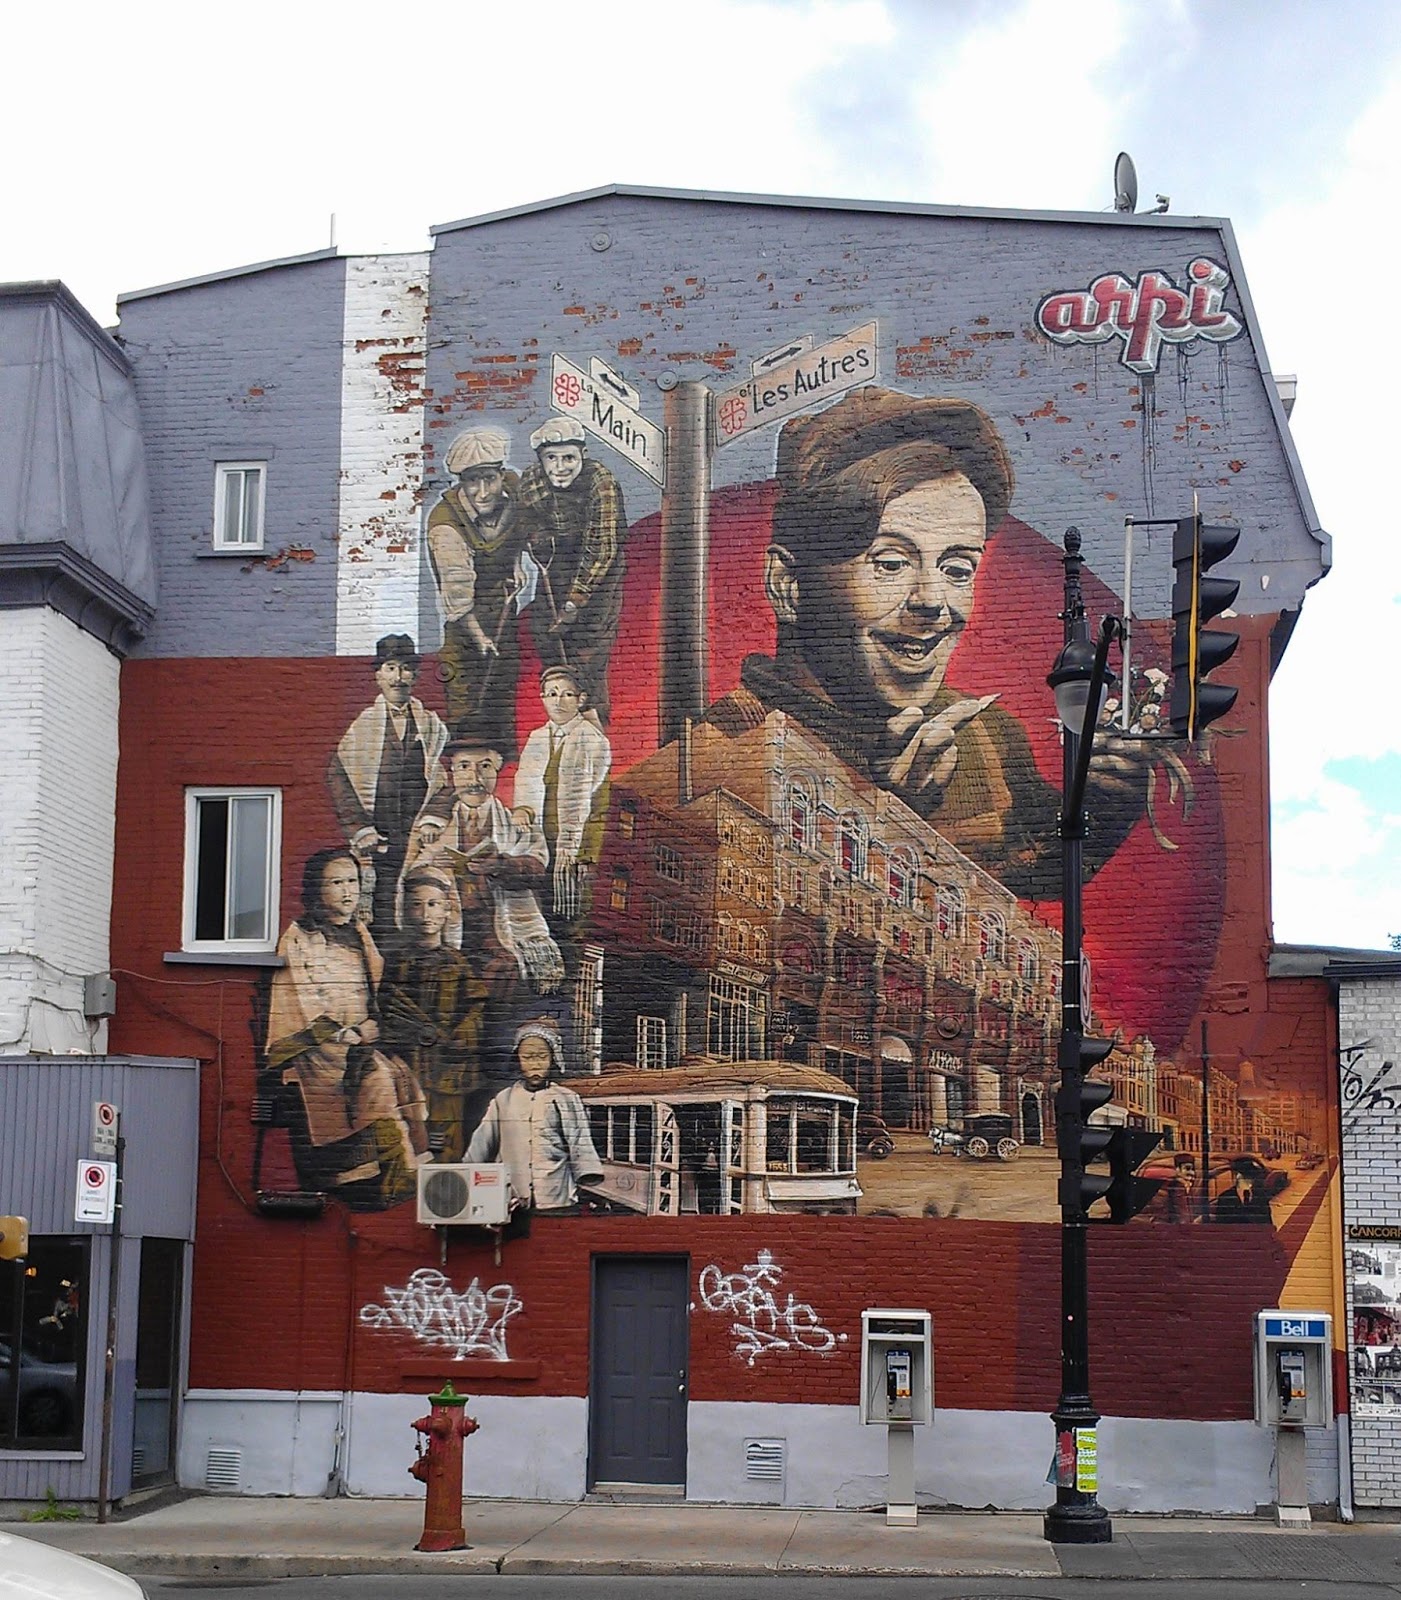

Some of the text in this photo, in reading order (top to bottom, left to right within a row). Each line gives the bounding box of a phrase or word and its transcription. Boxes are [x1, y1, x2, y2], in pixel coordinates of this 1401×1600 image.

[752, 383, 789, 414] Les
[794, 349, 870, 397] Autres
[1281, 1320, 1309, 1336] Bell
